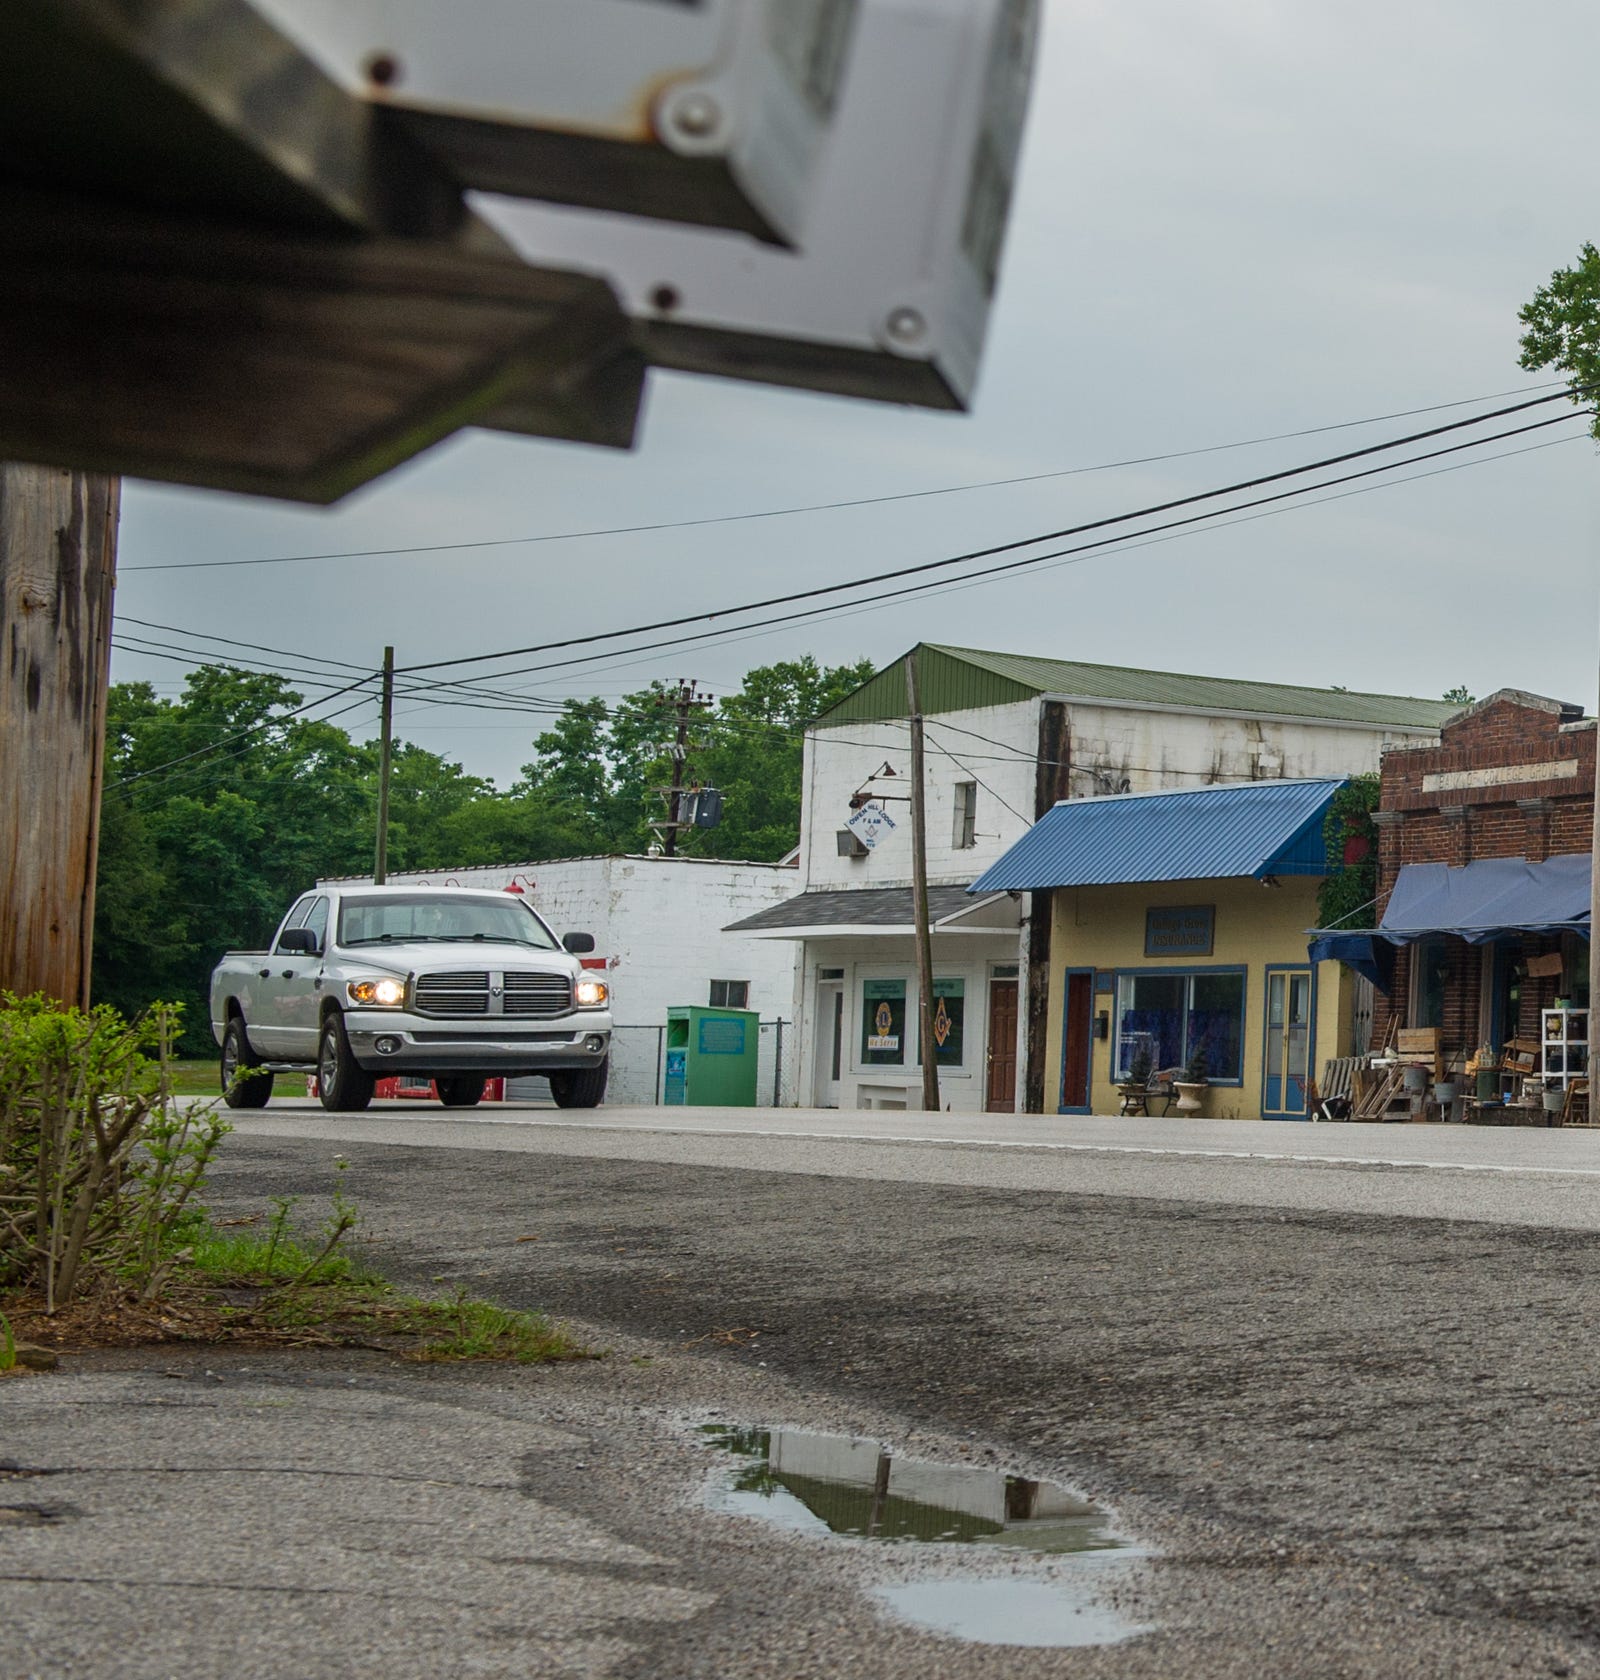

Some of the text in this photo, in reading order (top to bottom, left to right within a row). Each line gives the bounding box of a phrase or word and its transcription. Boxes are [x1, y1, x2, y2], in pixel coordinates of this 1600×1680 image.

[1439, 762, 1559, 789] BANK OF COLLEGE GROVE
[849, 808, 868, 825] OWEN
[878, 810, 897, 829] LODGE
